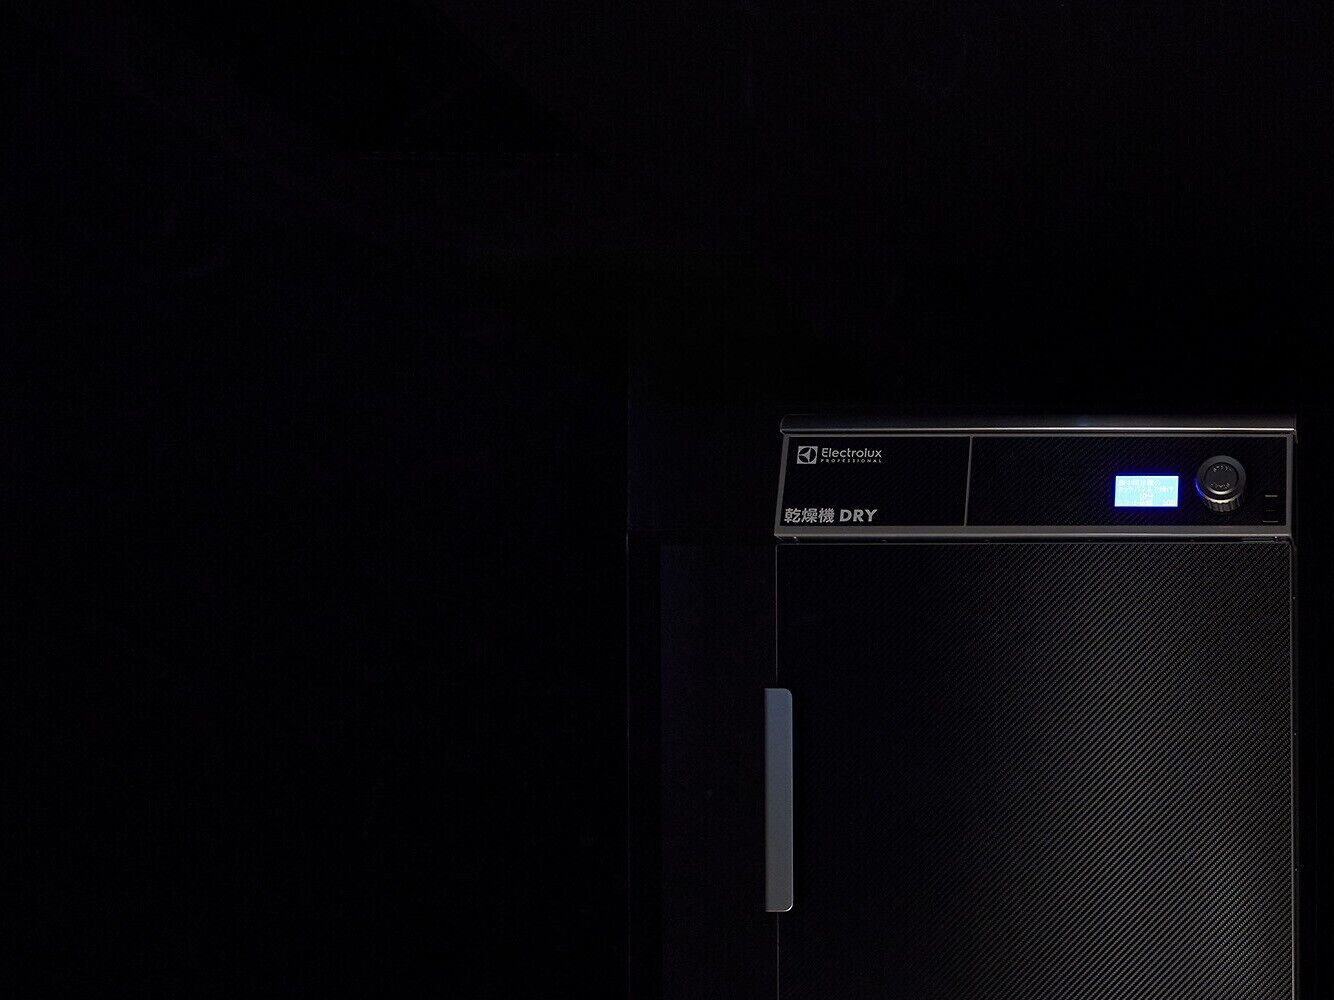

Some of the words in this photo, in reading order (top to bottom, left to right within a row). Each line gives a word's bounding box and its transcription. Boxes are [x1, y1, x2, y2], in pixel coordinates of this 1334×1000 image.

[821, 447, 882, 458] Electrolux
[784, 508, 835, 523] 乾燥機
[839, 509, 878, 522] DRY
